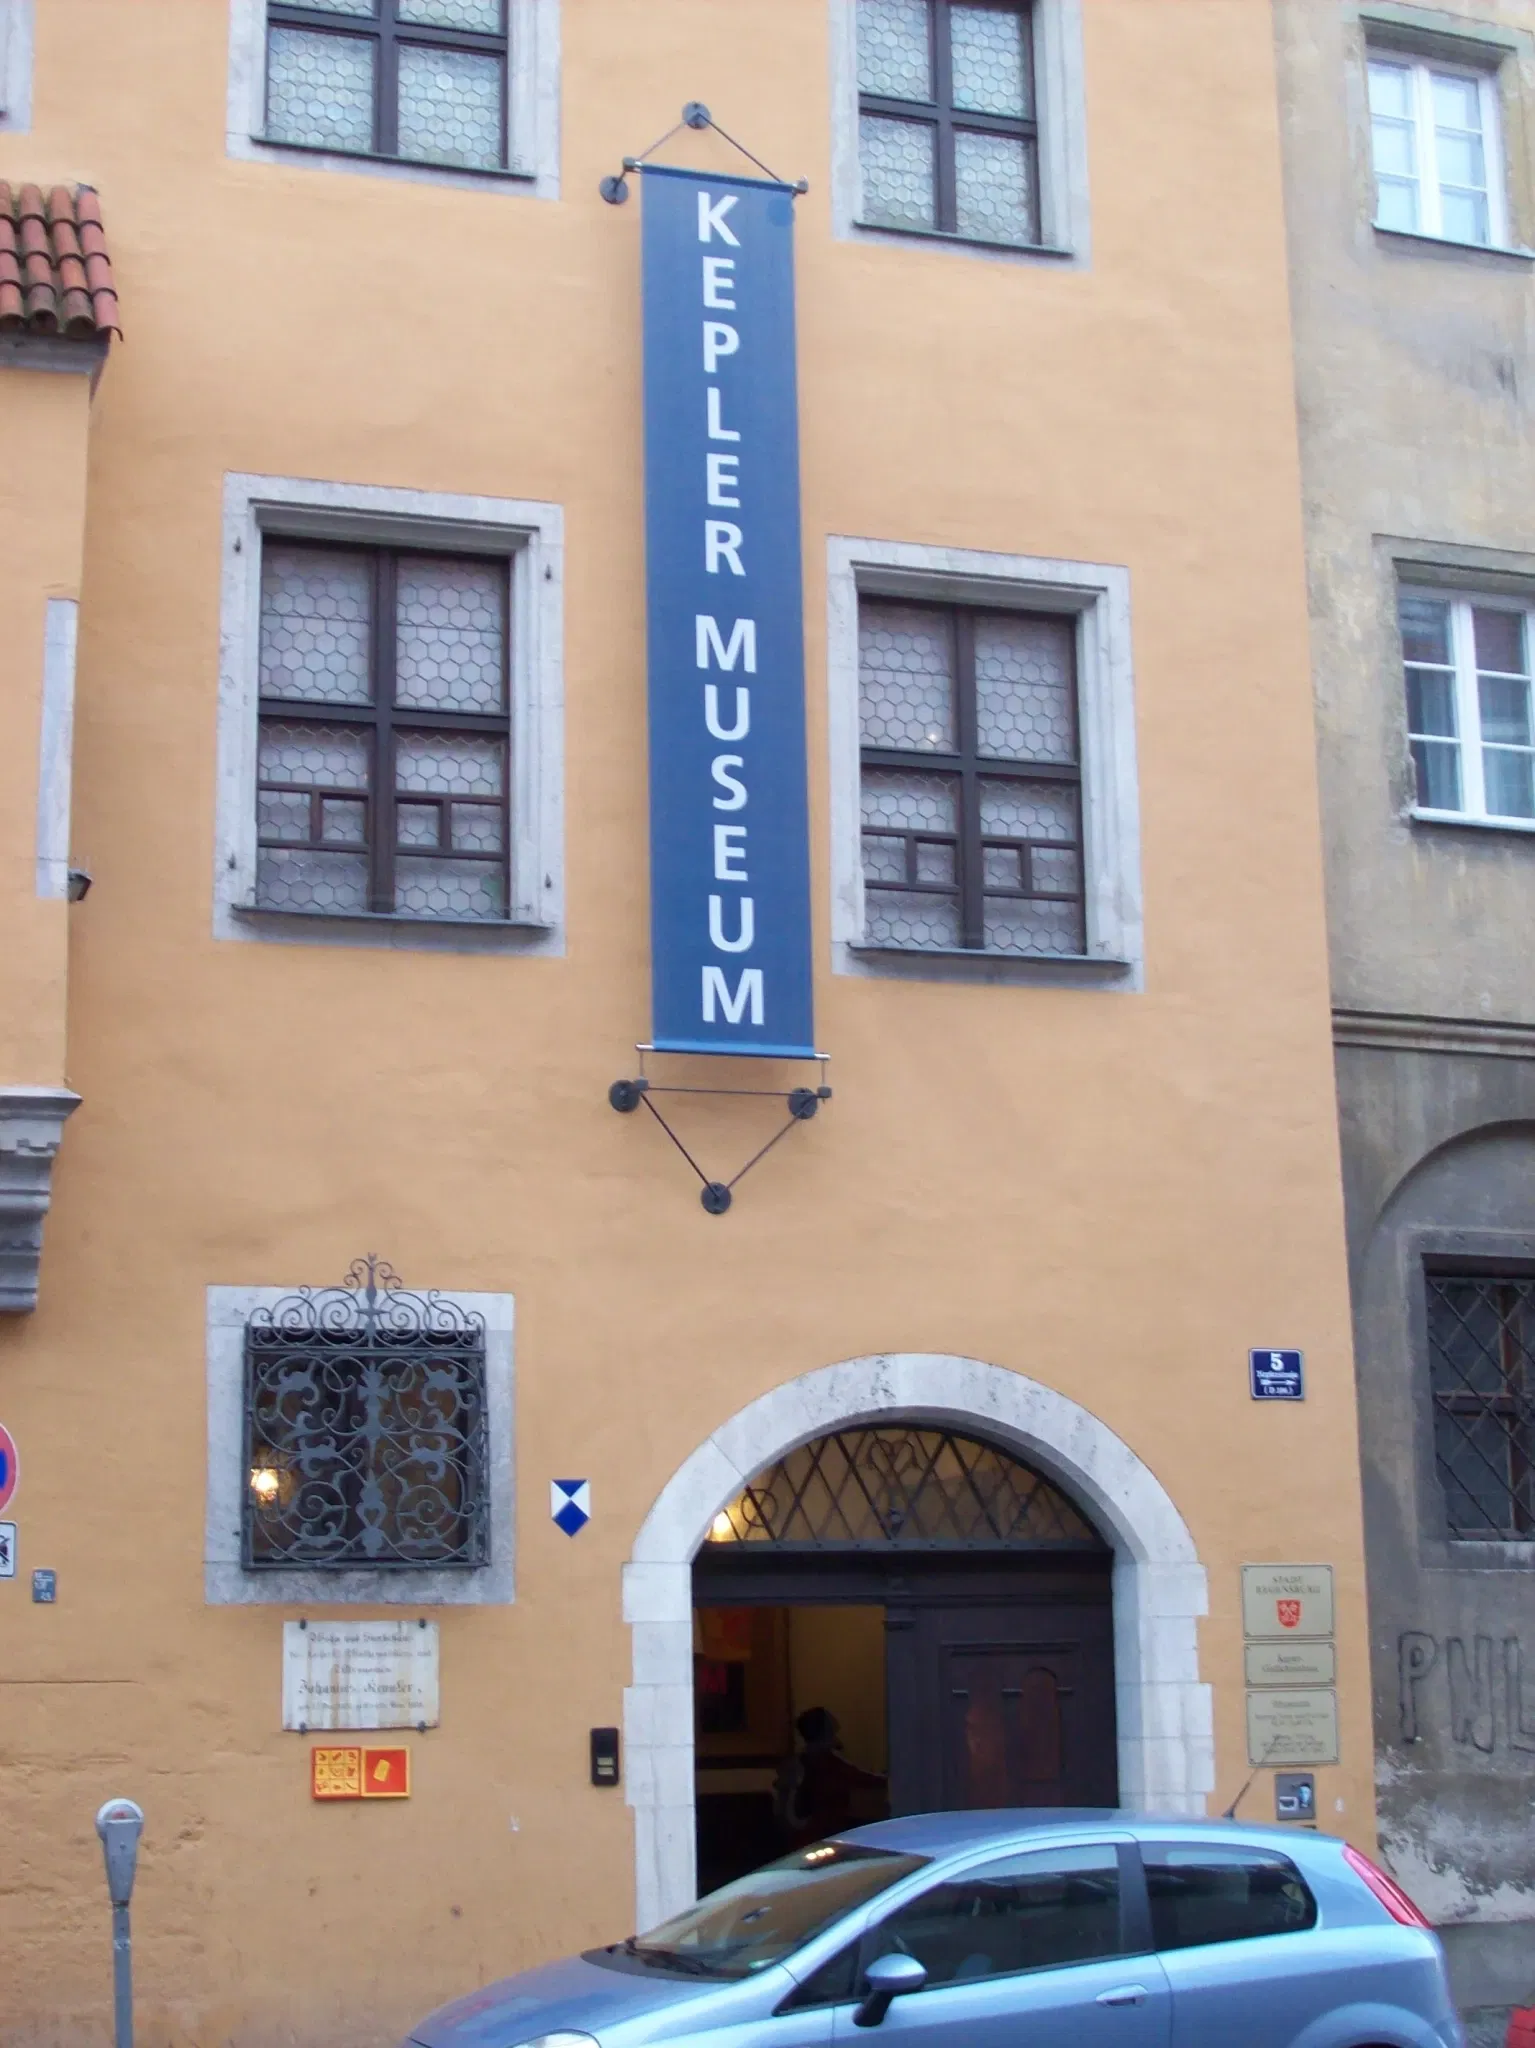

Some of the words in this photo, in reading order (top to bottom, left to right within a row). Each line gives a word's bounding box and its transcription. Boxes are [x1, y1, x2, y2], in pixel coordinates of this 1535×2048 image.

[697, 191, 746, 576] KEPLER
[695, 614, 765, 1025] MUSEUM
[1270, 1352, 1285, 1371] 5
